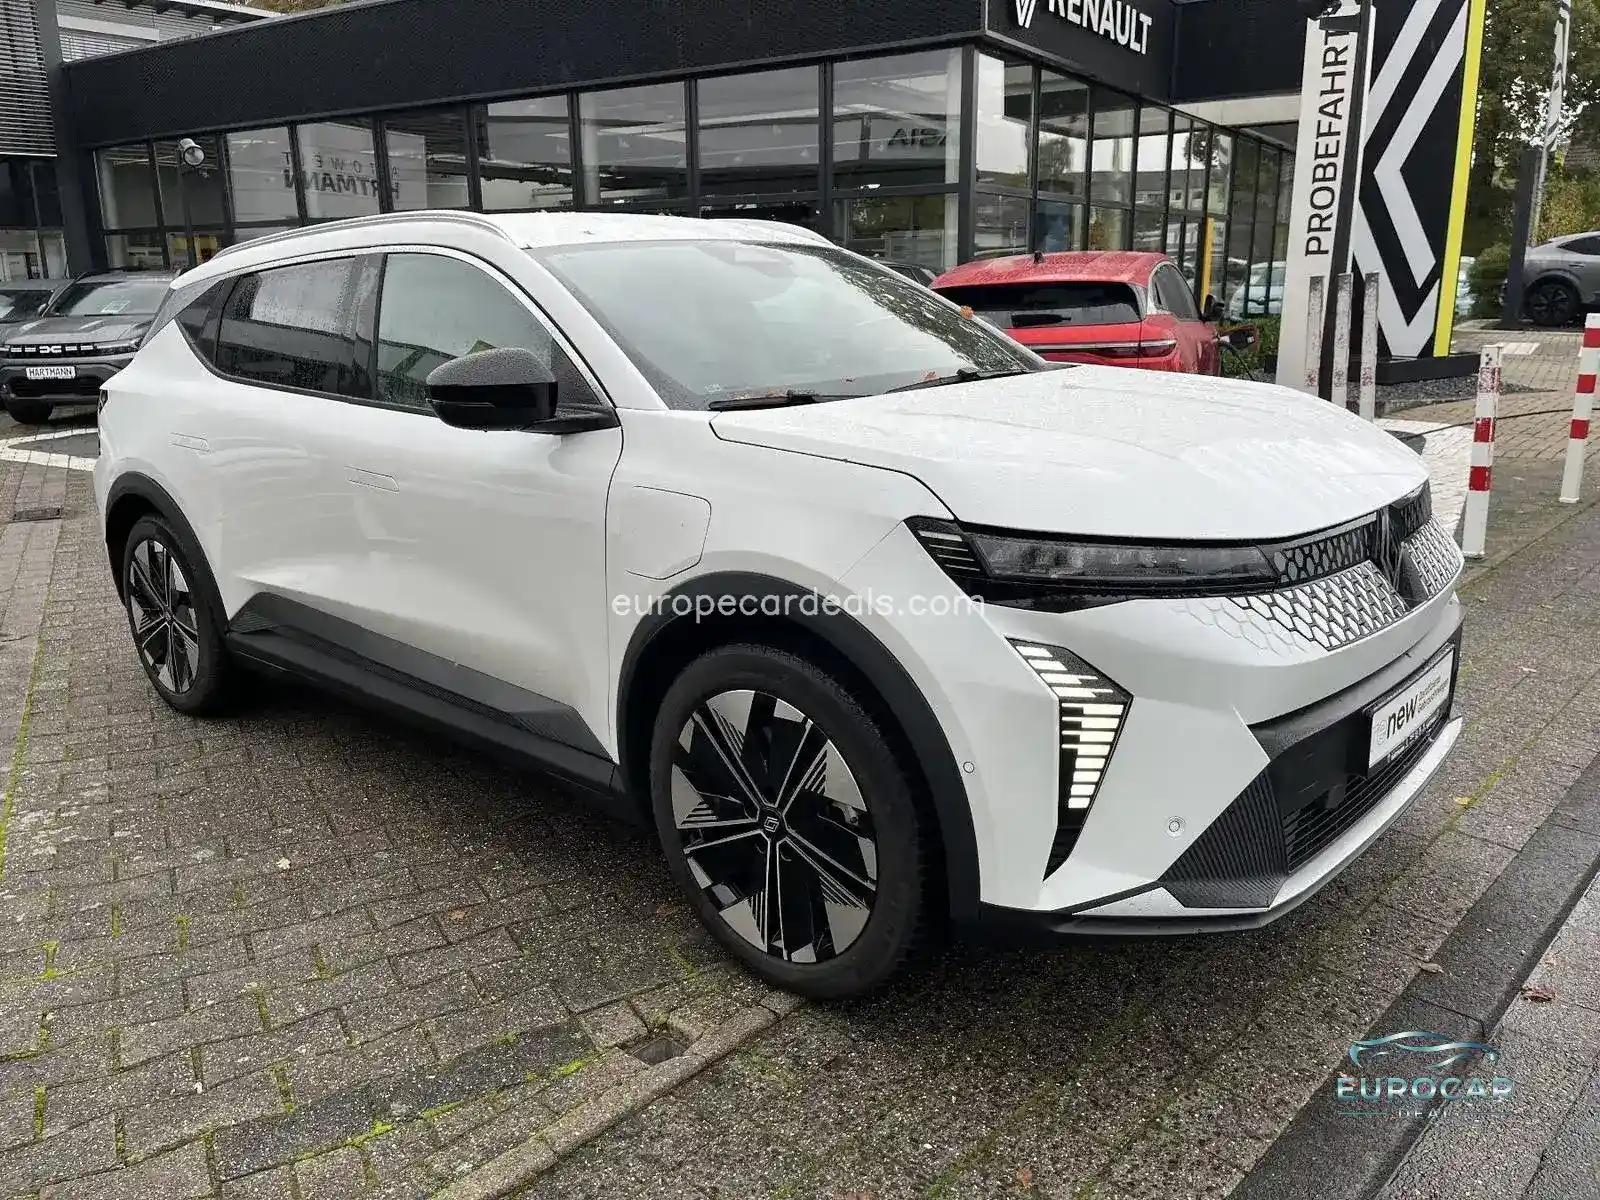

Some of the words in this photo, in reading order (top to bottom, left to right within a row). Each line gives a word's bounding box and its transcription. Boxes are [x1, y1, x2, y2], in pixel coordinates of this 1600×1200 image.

[1305, 29, 1350, 257] PROBEFAHRT
[28, 367, 73, 378] HARTMANN
[1387, 694, 1418, 739] new
